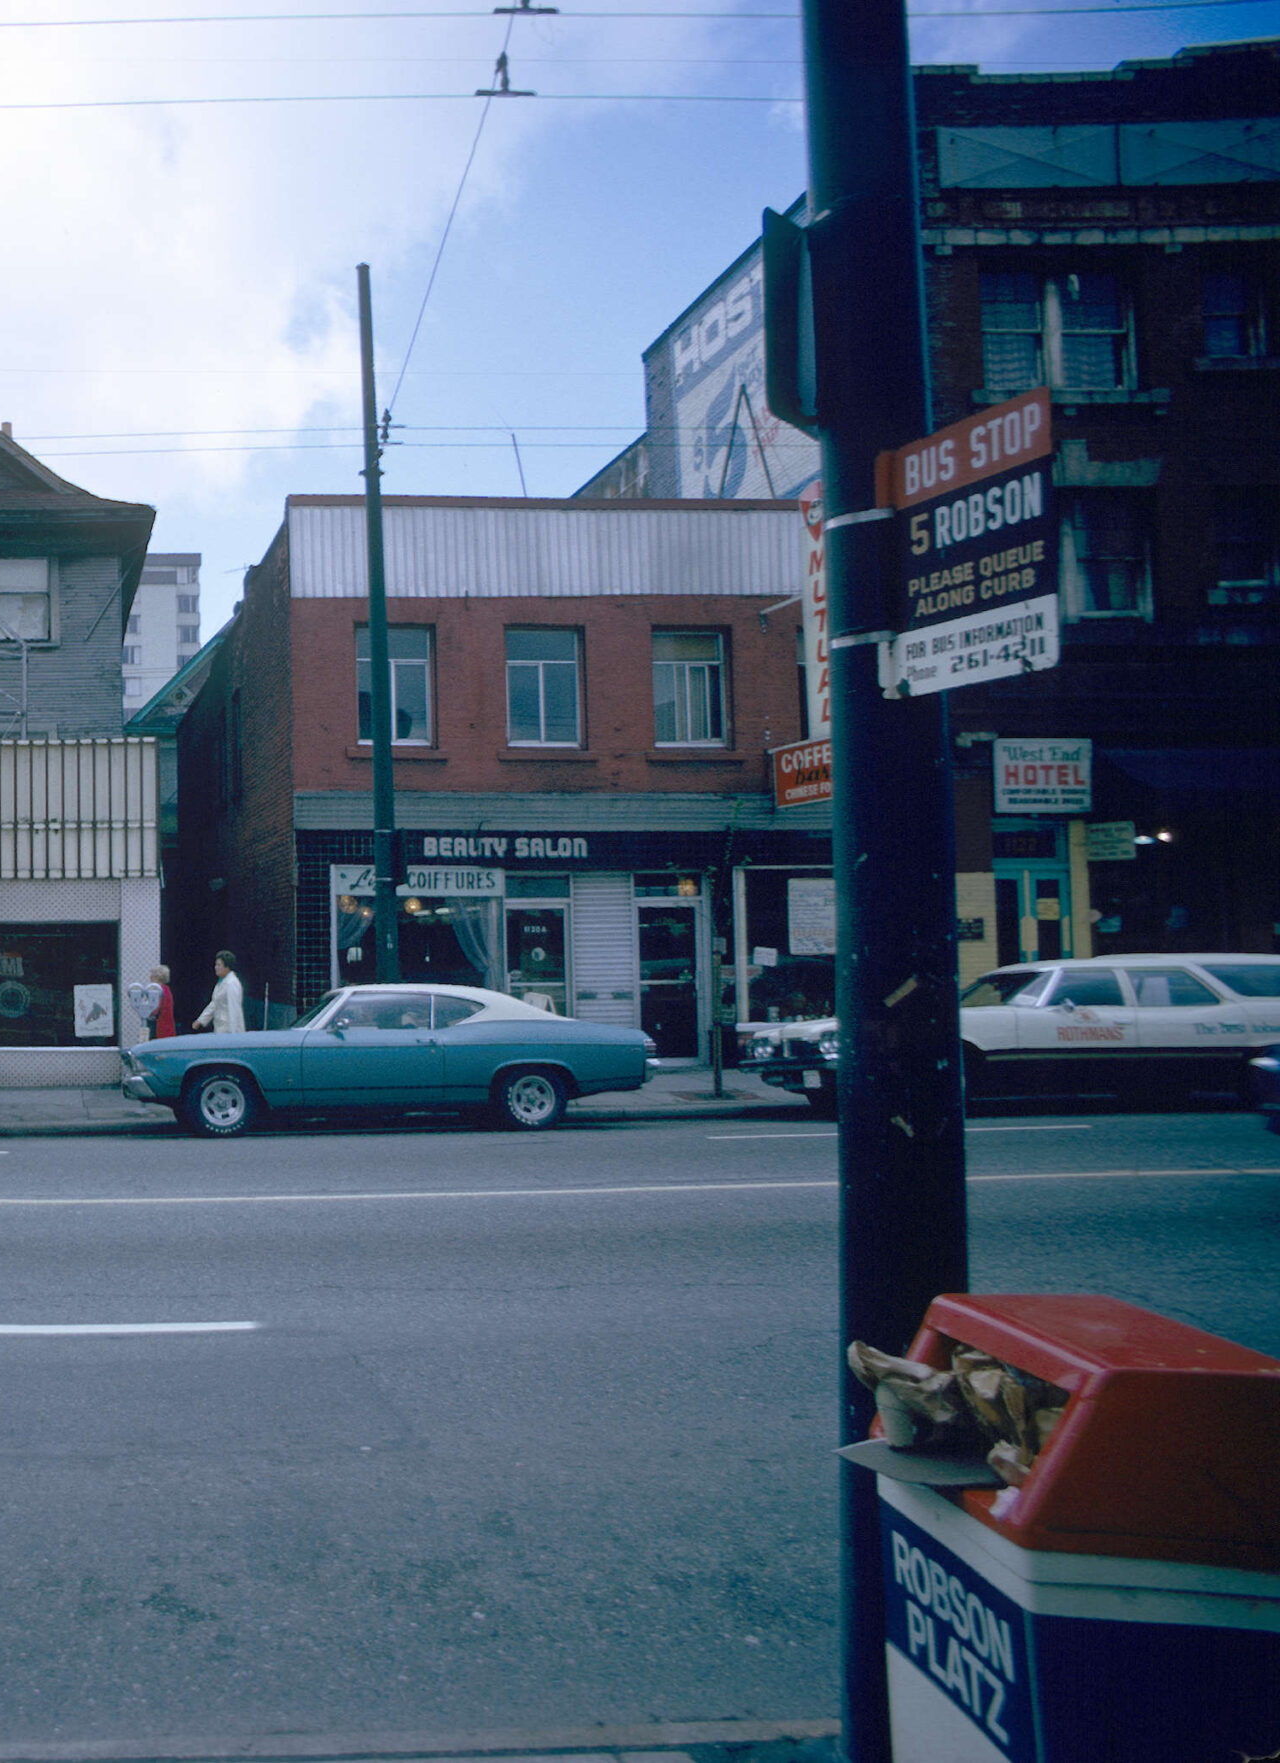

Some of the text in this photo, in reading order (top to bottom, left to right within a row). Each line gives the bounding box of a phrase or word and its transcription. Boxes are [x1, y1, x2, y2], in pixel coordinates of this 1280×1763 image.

[905, 402, 1041, 496] BUS STOP
[910, 472, 1042, 556] 5 ROBSON
[908, 540, 1045, 598] PLEASE QUEUE
[914, 567, 1036, 618] ALONG CURB
[906, 611, 1045, 662] FOR BUS INFORMATION
[906, 636, 1046, 683] Phone 261-4211
[781, 744, 832, 774] COFFE
[1002, 745, 1082, 761] West End
[1004, 764, 1086, 786] HOTEL
[820, 781, 832, 794] FO
[423, 836, 588, 858] BEAUTY SALON
[406, 870, 497, 890] COIFFURES
[1056, 1026, 1125, 1042] ROTHMANS
[891, 1528, 1015, 1685] ROBSON
[906, 1599, 1010, 1747] PLATZ
